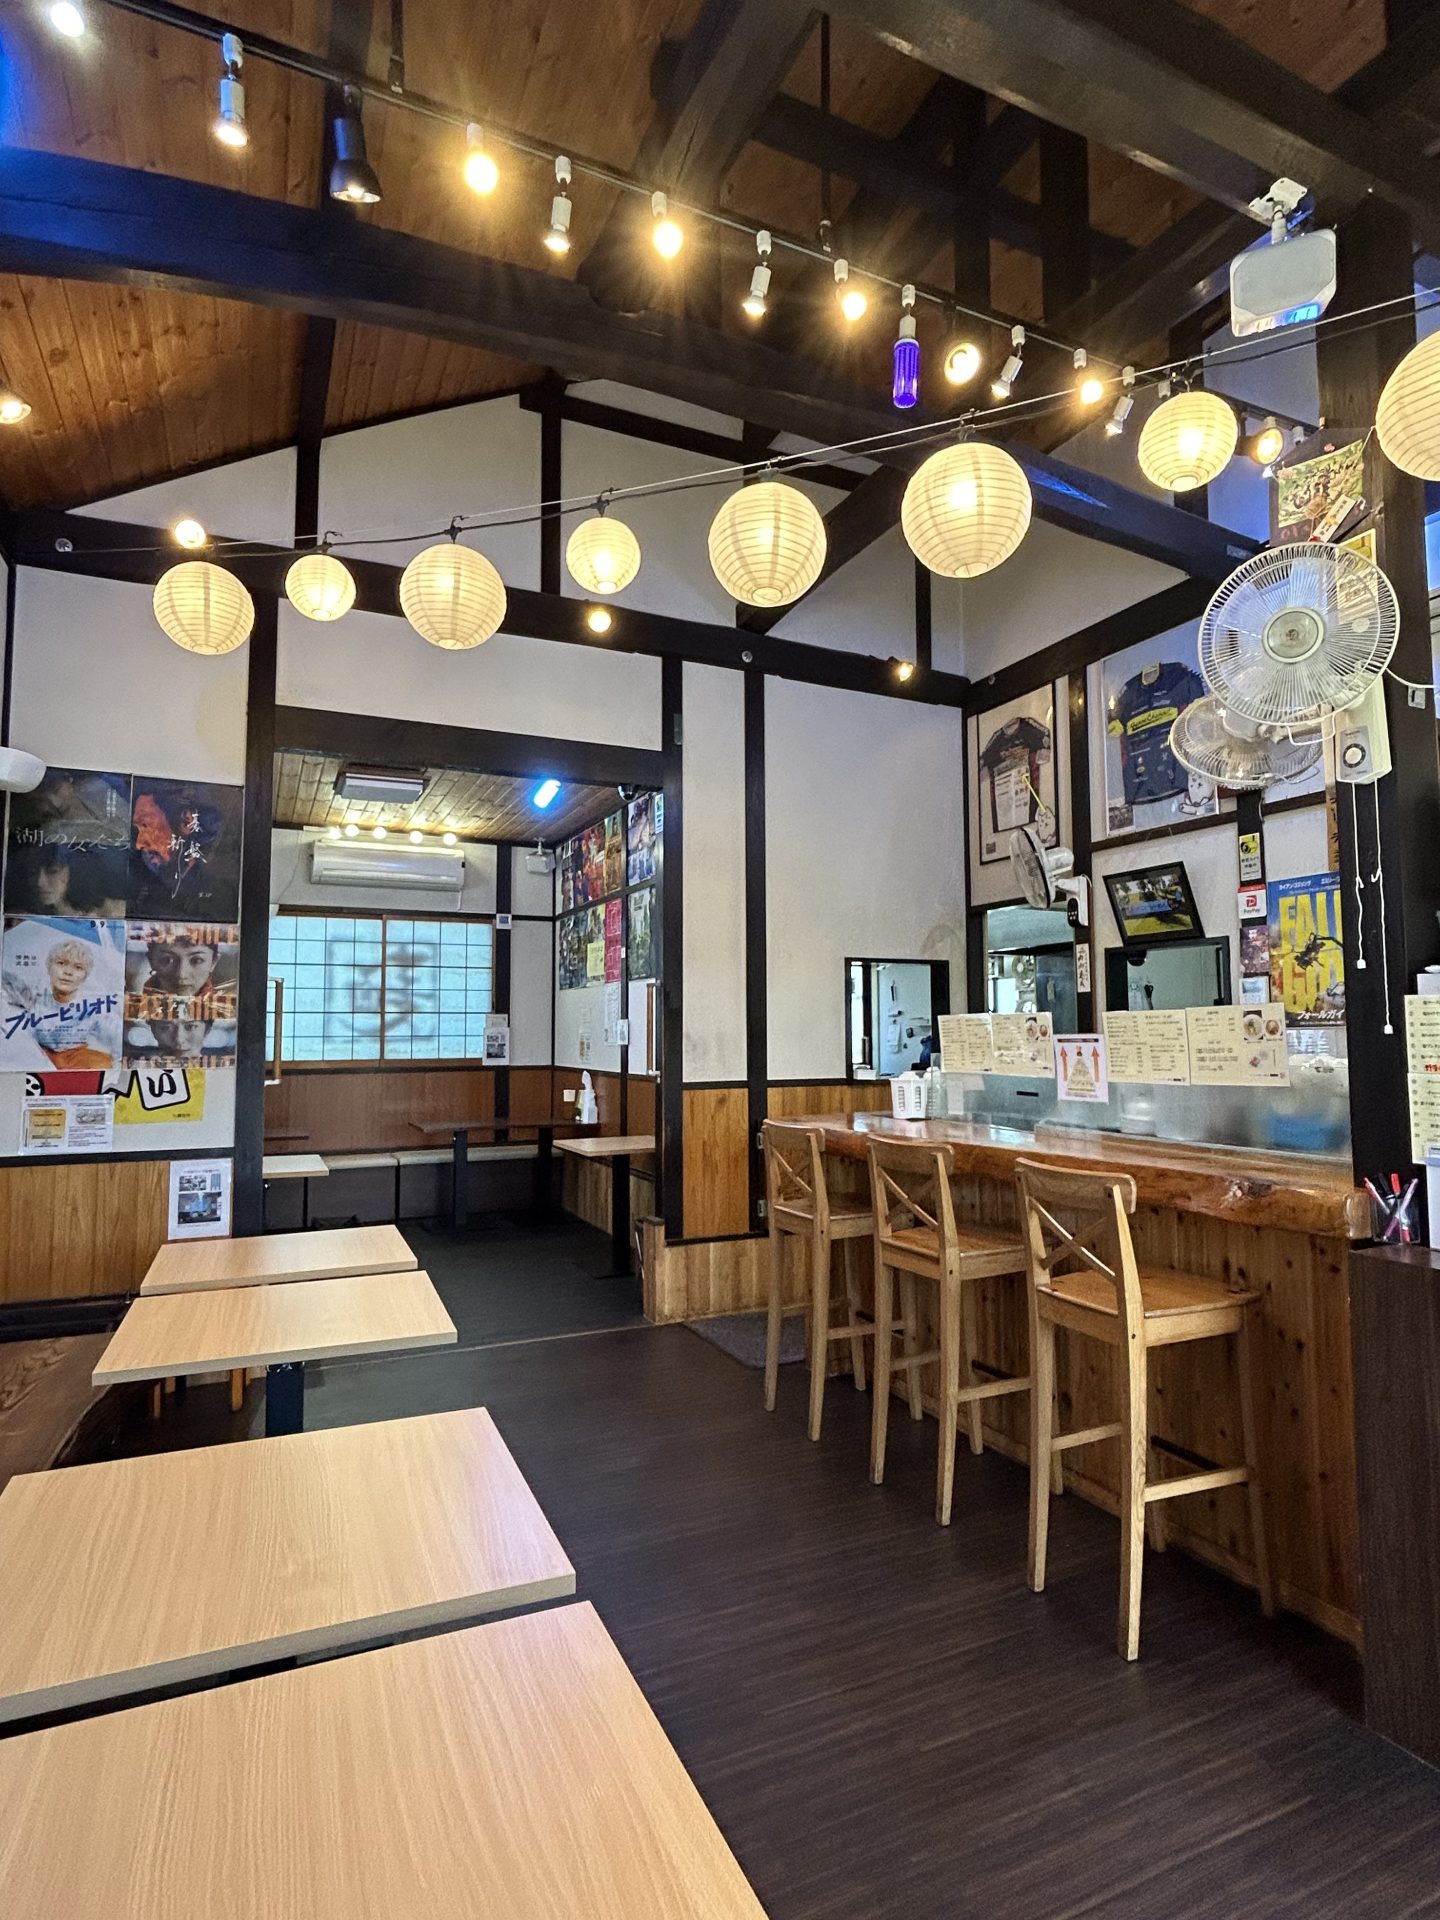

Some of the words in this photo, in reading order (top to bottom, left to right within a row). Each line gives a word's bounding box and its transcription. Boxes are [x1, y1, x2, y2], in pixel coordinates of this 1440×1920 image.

[5, 993, 118, 1039] ブルーピリオド
[1297, 1009, 1345, 1020] フォールガイ
